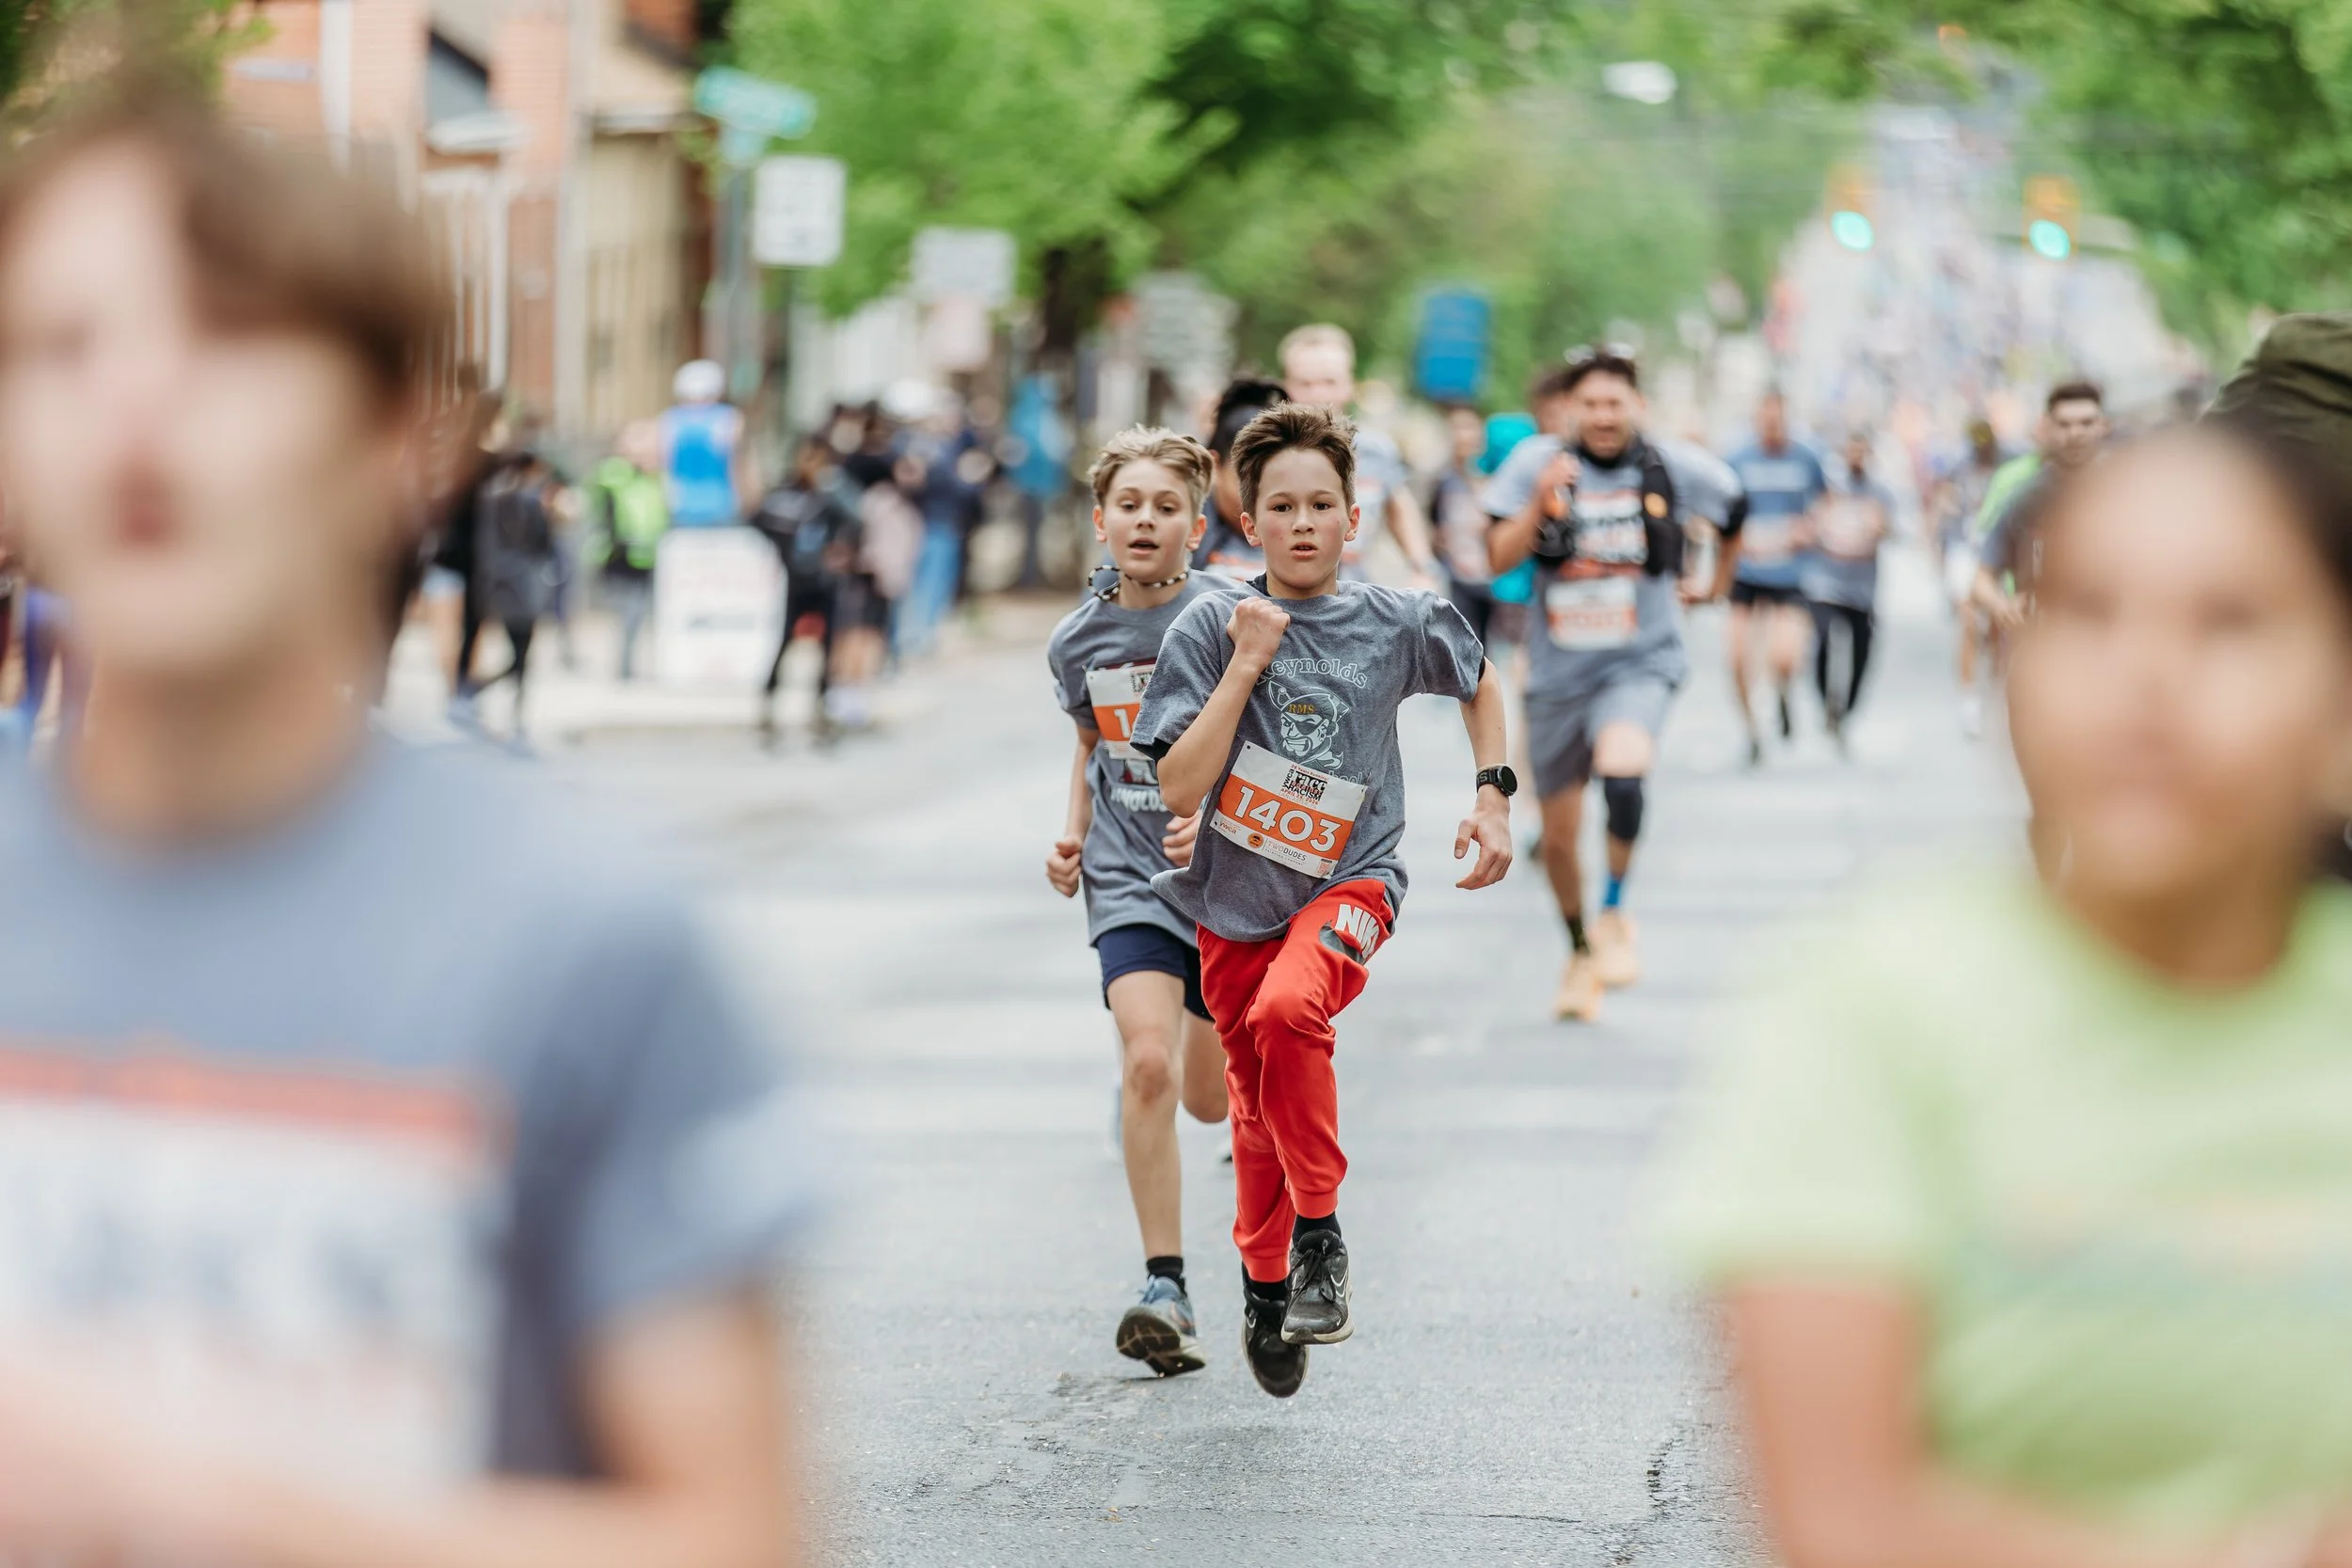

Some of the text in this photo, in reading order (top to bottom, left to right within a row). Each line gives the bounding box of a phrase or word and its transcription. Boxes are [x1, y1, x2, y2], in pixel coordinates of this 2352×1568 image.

[1288, 704, 1315, 714] RMS
[1290, 771, 1327, 792] race
[1288, 784, 1323, 801] RACISM
[1234, 785, 1342, 852] 1403
